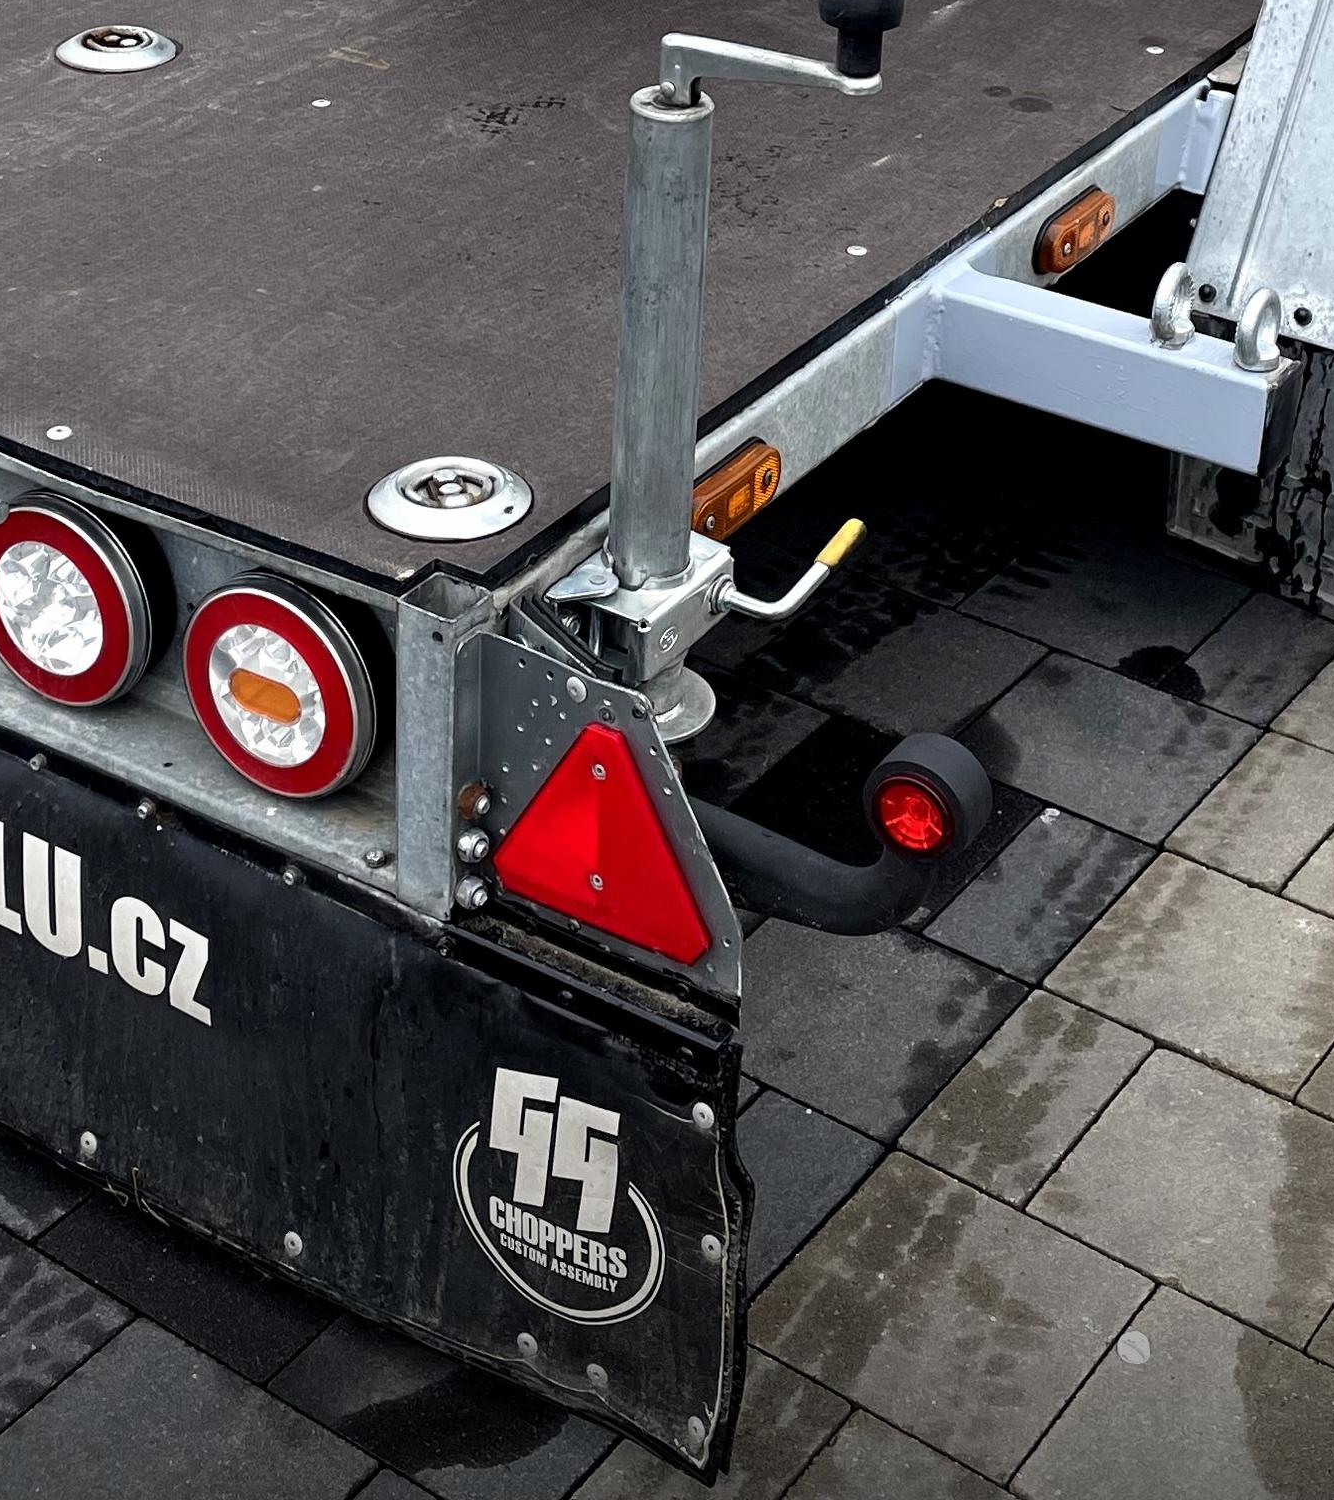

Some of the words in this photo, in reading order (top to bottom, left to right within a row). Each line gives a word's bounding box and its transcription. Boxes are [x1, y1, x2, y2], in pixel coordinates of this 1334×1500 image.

[488, 1195, 628, 1279] CHOPPERS
[499, 1232, 548, 1268] CUSTOM
[551, 1257, 619, 1294] ASSEMBLY
